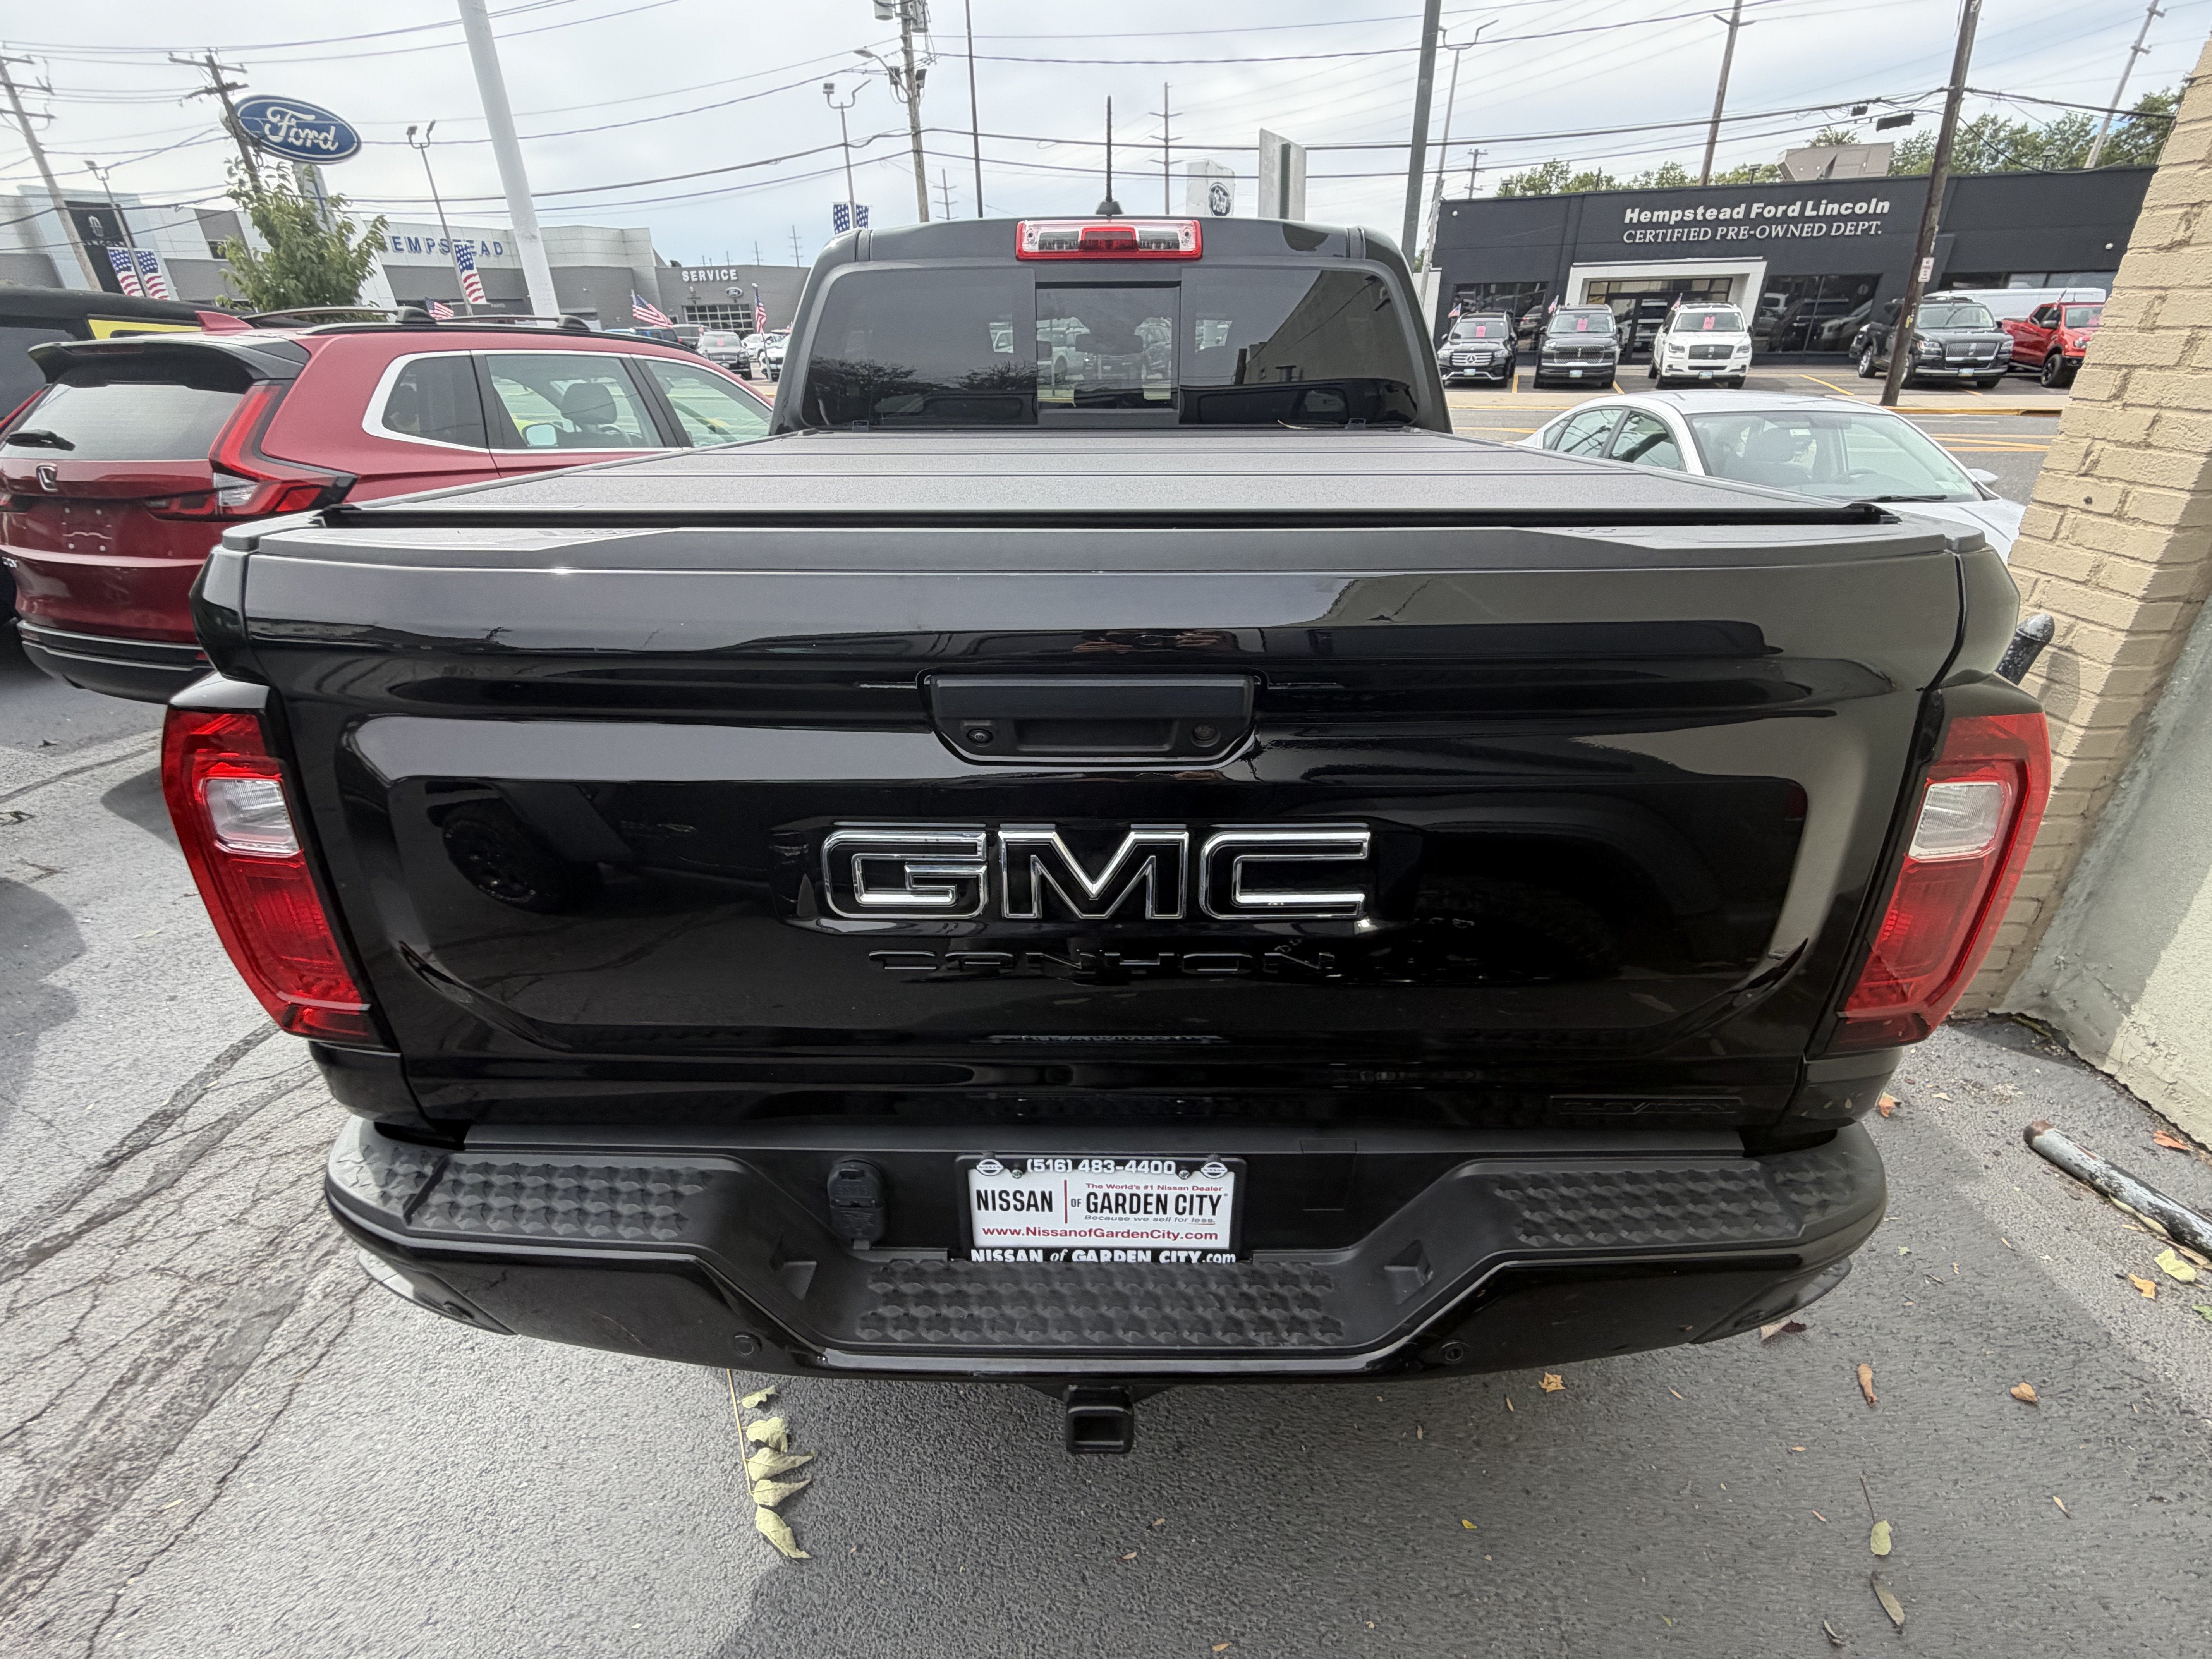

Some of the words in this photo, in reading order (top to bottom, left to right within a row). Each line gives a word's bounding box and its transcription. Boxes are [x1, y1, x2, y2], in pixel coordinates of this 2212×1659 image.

[264, 106, 338, 151] Ford
[1624, 203, 1746, 225] Hempstead
[1750, 201, 1802, 219] Ford
[1804, 198, 1890, 216] Lincoln
[1623, 227, 1712, 243] CERTIFIED
[1715, 223, 1827, 240] PRE-OWNED
[1830, 221, 1882, 236] DEPT.
[391, 236, 503, 256] EMPSEAD
[682, 269, 738, 282] SERVICE
[822, 823, 1371, 920] GMC
[1027, 1158, 1073, 1173] (516)
[1078, 1159, 1176, 1174] 483-4400
[976, 1189, 1053, 1212] NISSAN
[1071, 1198, 1082, 1207] OF
[1086, 1192, 1168, 1215] GARDEN
[1175, 1193, 1222, 1216] CITY
[982, 1226, 1218, 1241] www.NissanofGardenCity.com
[971, 1249, 1043, 1262] NISSAN
[1050, 1249, 1068, 1262] of
[1072, 1249, 1152, 1263] GARDEN
[1159, 1250, 1236, 1264] CITY.com
